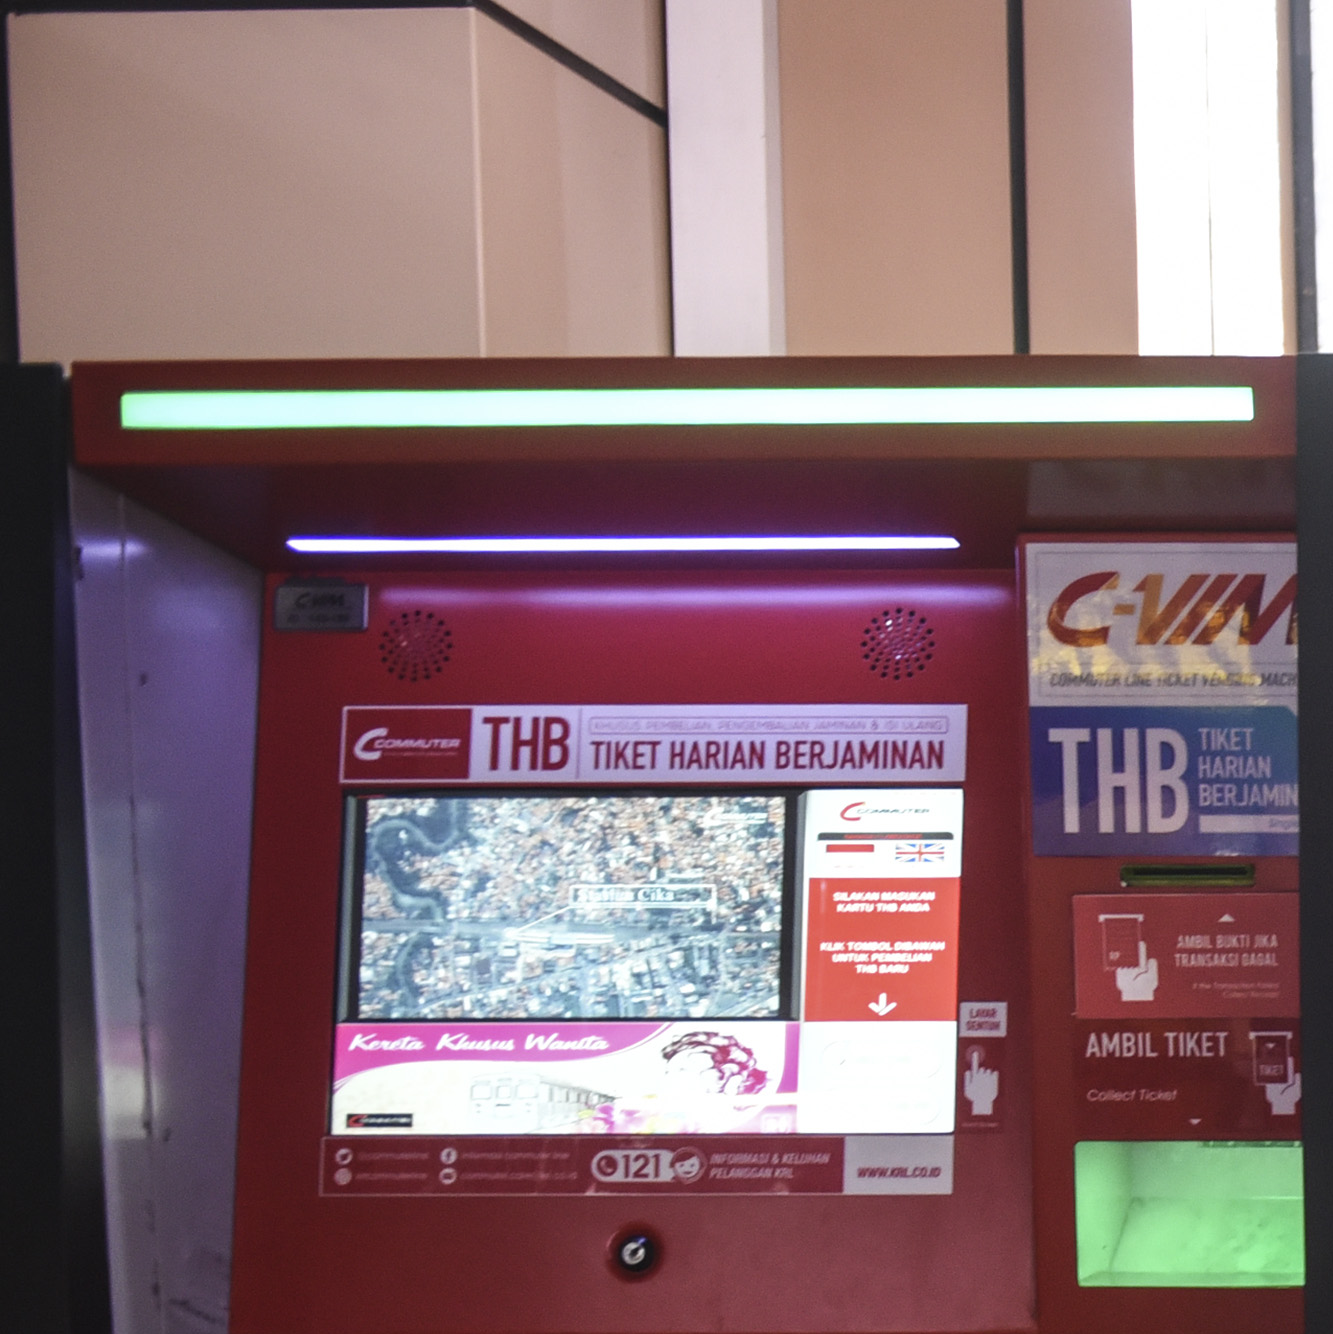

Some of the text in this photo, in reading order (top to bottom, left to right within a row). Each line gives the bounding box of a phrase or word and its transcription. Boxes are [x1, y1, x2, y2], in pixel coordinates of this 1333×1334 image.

[1050, 672, 1197, 688] COMMUTER LINE TICKET
[482, 716, 571, 771] THB
[1199, 728, 1254, 751] TIKET
[591, 740, 945, 770] TIKET HARIAN BERJAMINAN
[1199, 756, 1271, 779] HARIAN
[1048, 728, 1189, 834] THB
[348, 1033, 610, 1051] Kereta Khusus Wanita
[1085, 1032, 1229, 1058] AMBIL TIKET
[1087, 1089, 1178, 1102] Collect Ticket
[621, 1154, 661, 1178] 121
[857, 1167, 942, 1179] WWW.KRL.CO.ID
